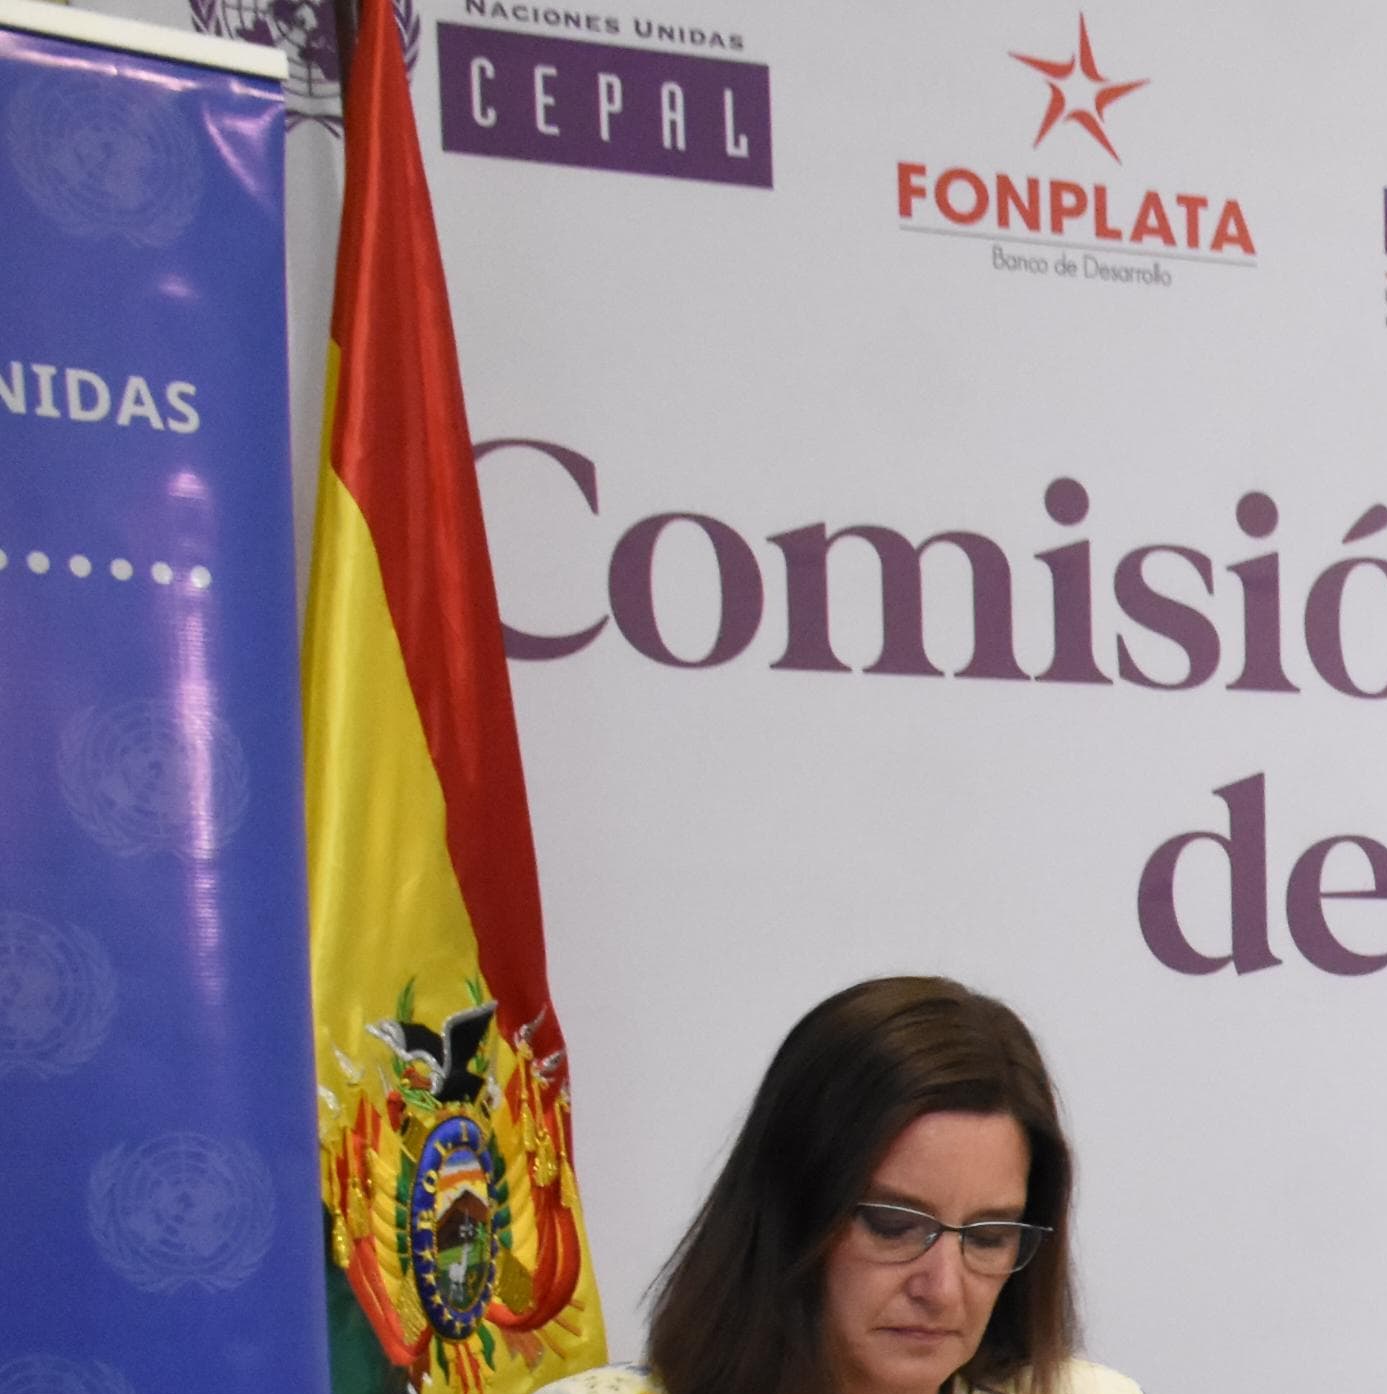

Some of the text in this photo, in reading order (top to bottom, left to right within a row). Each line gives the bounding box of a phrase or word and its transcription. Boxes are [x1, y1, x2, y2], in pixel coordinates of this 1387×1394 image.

[465, 0, 744, 50] NACIONES UNIDAS
[470, 56, 749, 158] CEPAL
[897, 162, 1256, 255] FONPLATA
[992, 244, 1172, 286] Banco de Desarrollo
